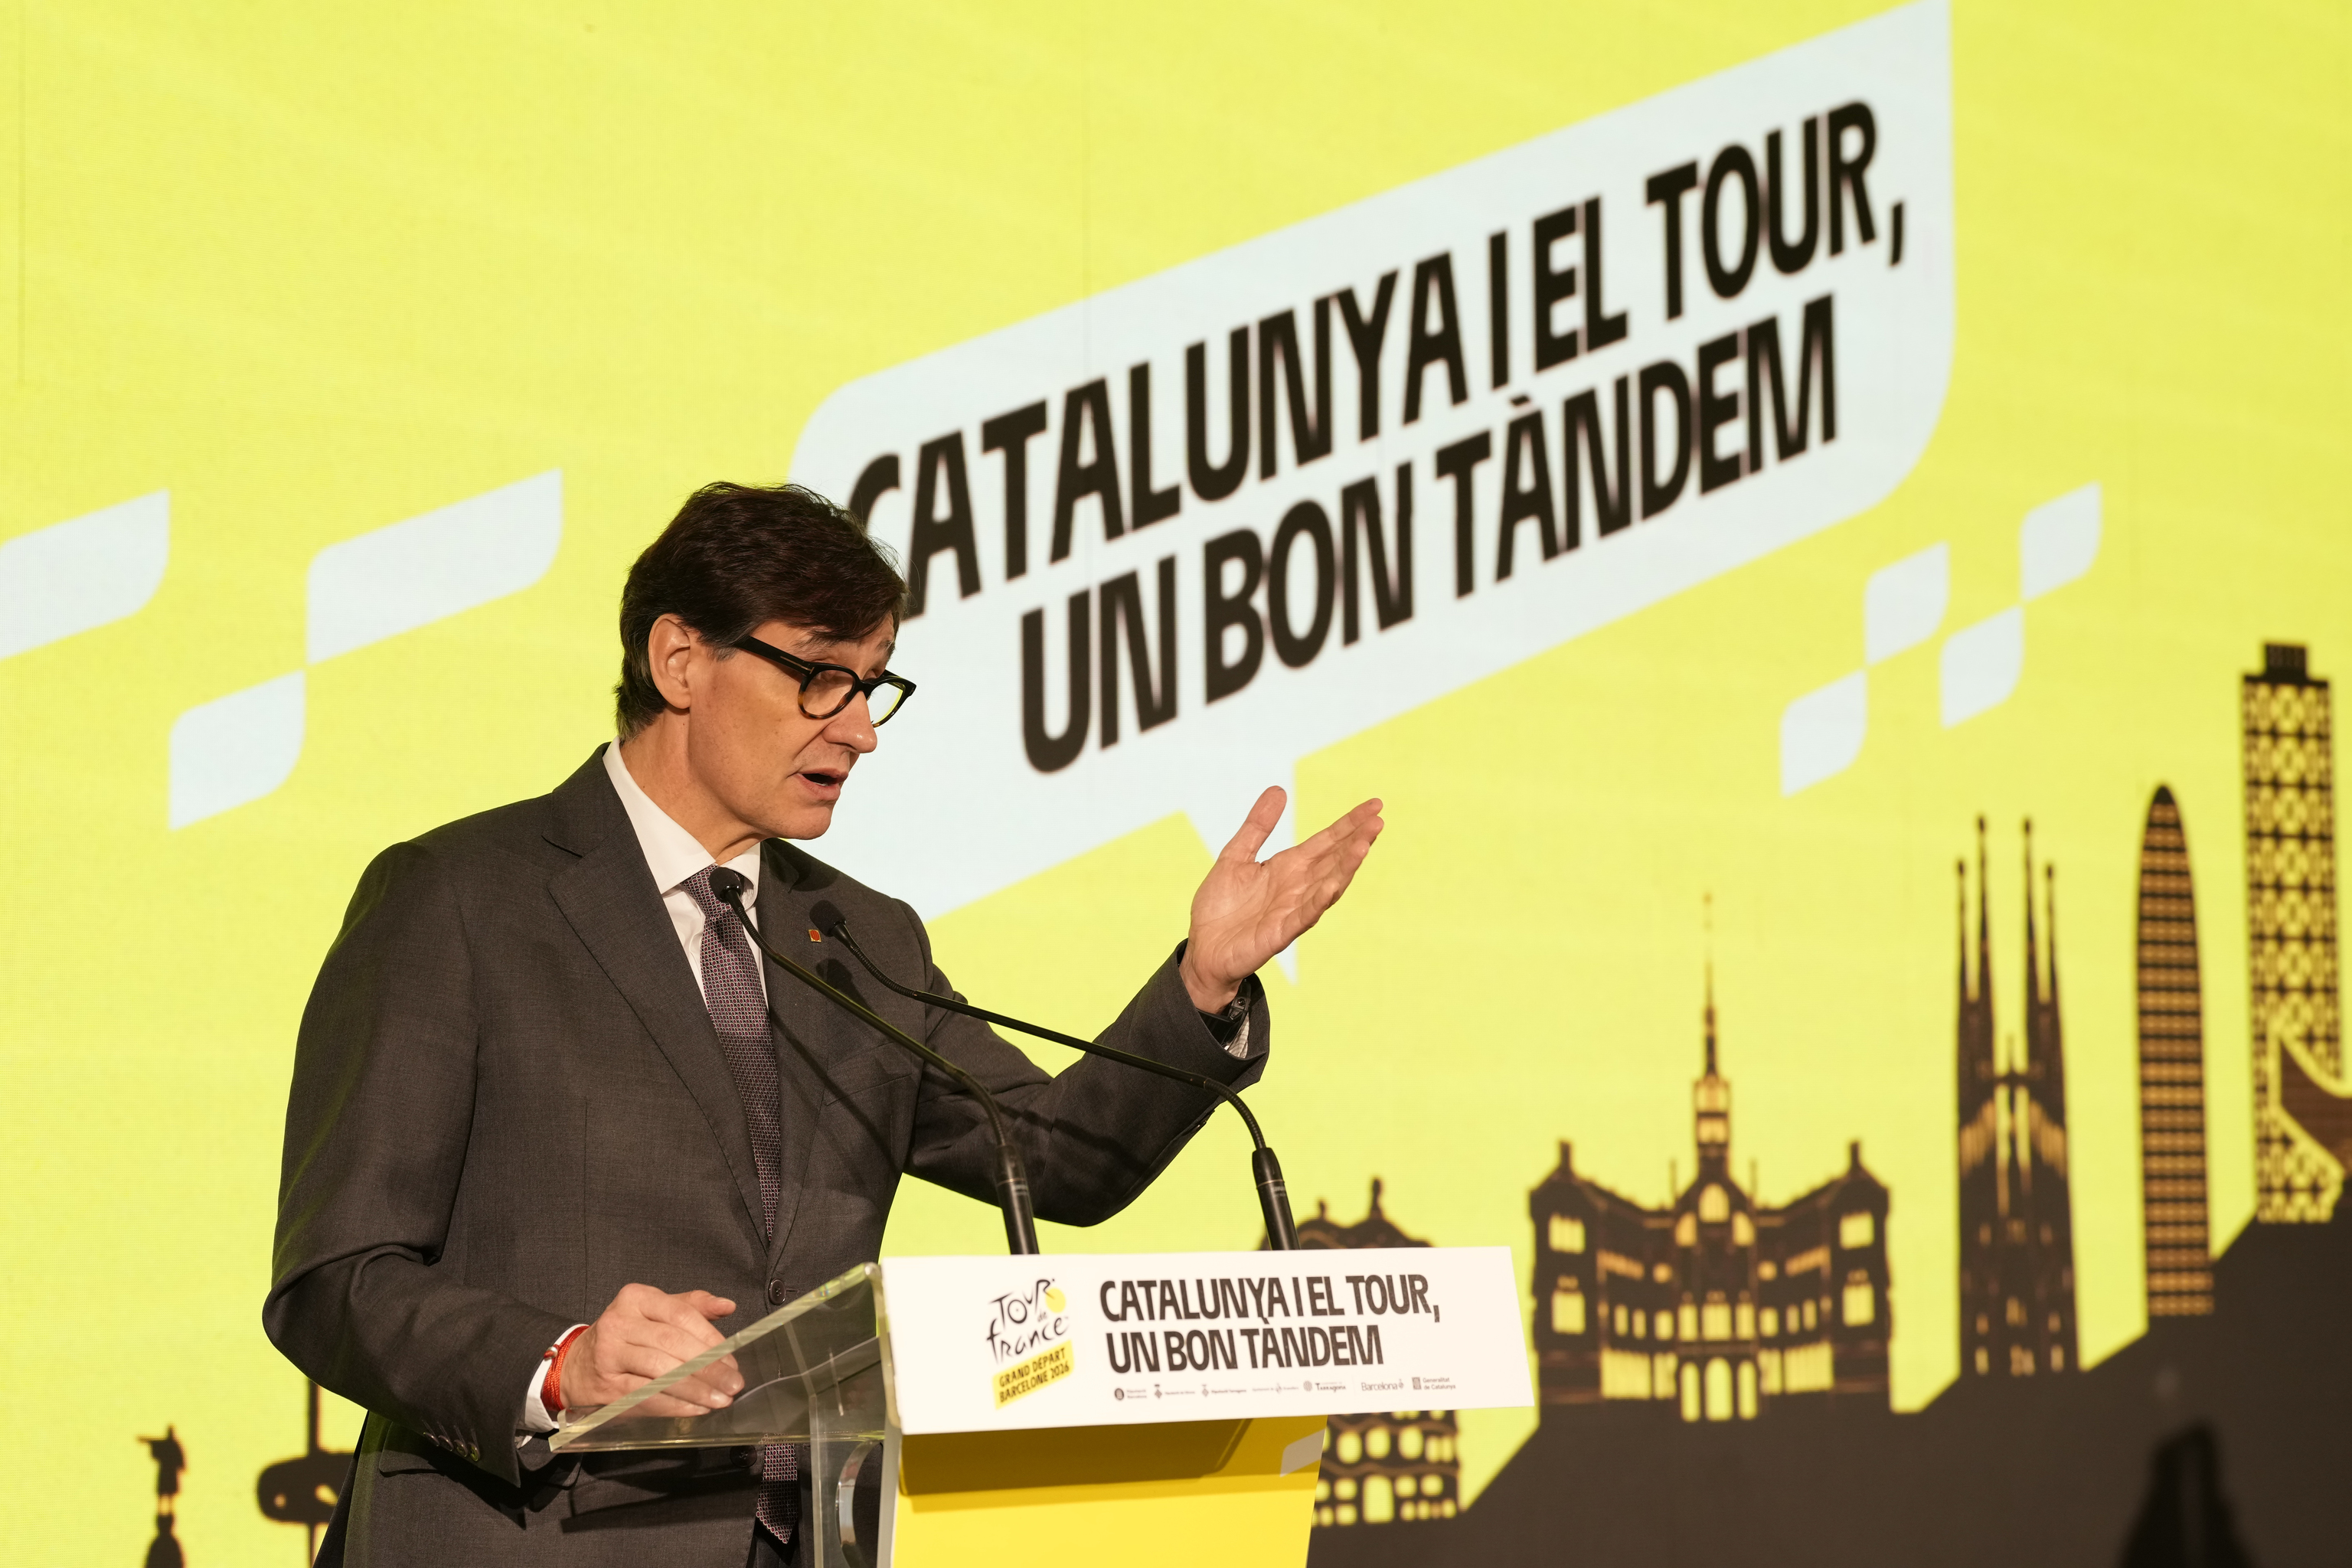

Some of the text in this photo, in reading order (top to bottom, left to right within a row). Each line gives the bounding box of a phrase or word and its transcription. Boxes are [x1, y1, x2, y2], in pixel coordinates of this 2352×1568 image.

[1488, 230, 1510, 390] I
[1532, 197, 1629, 373] EL
[1645, 100, 1906, 321] TOUR,
[1021, 292, 1838, 773] UN BON TÀNDEM
[1099, 1274, 1441, 1323] CATALUNYA I EL TOUR,
[999, 1347, 1066, 1388] GRAND DÉPART
[1106, 1317, 1384, 1374] UN BON TÀNDEM
[999, 1361, 1070, 1403] BARCELONE 2026
[1361, 1382, 1398, 1391] Barcelona
